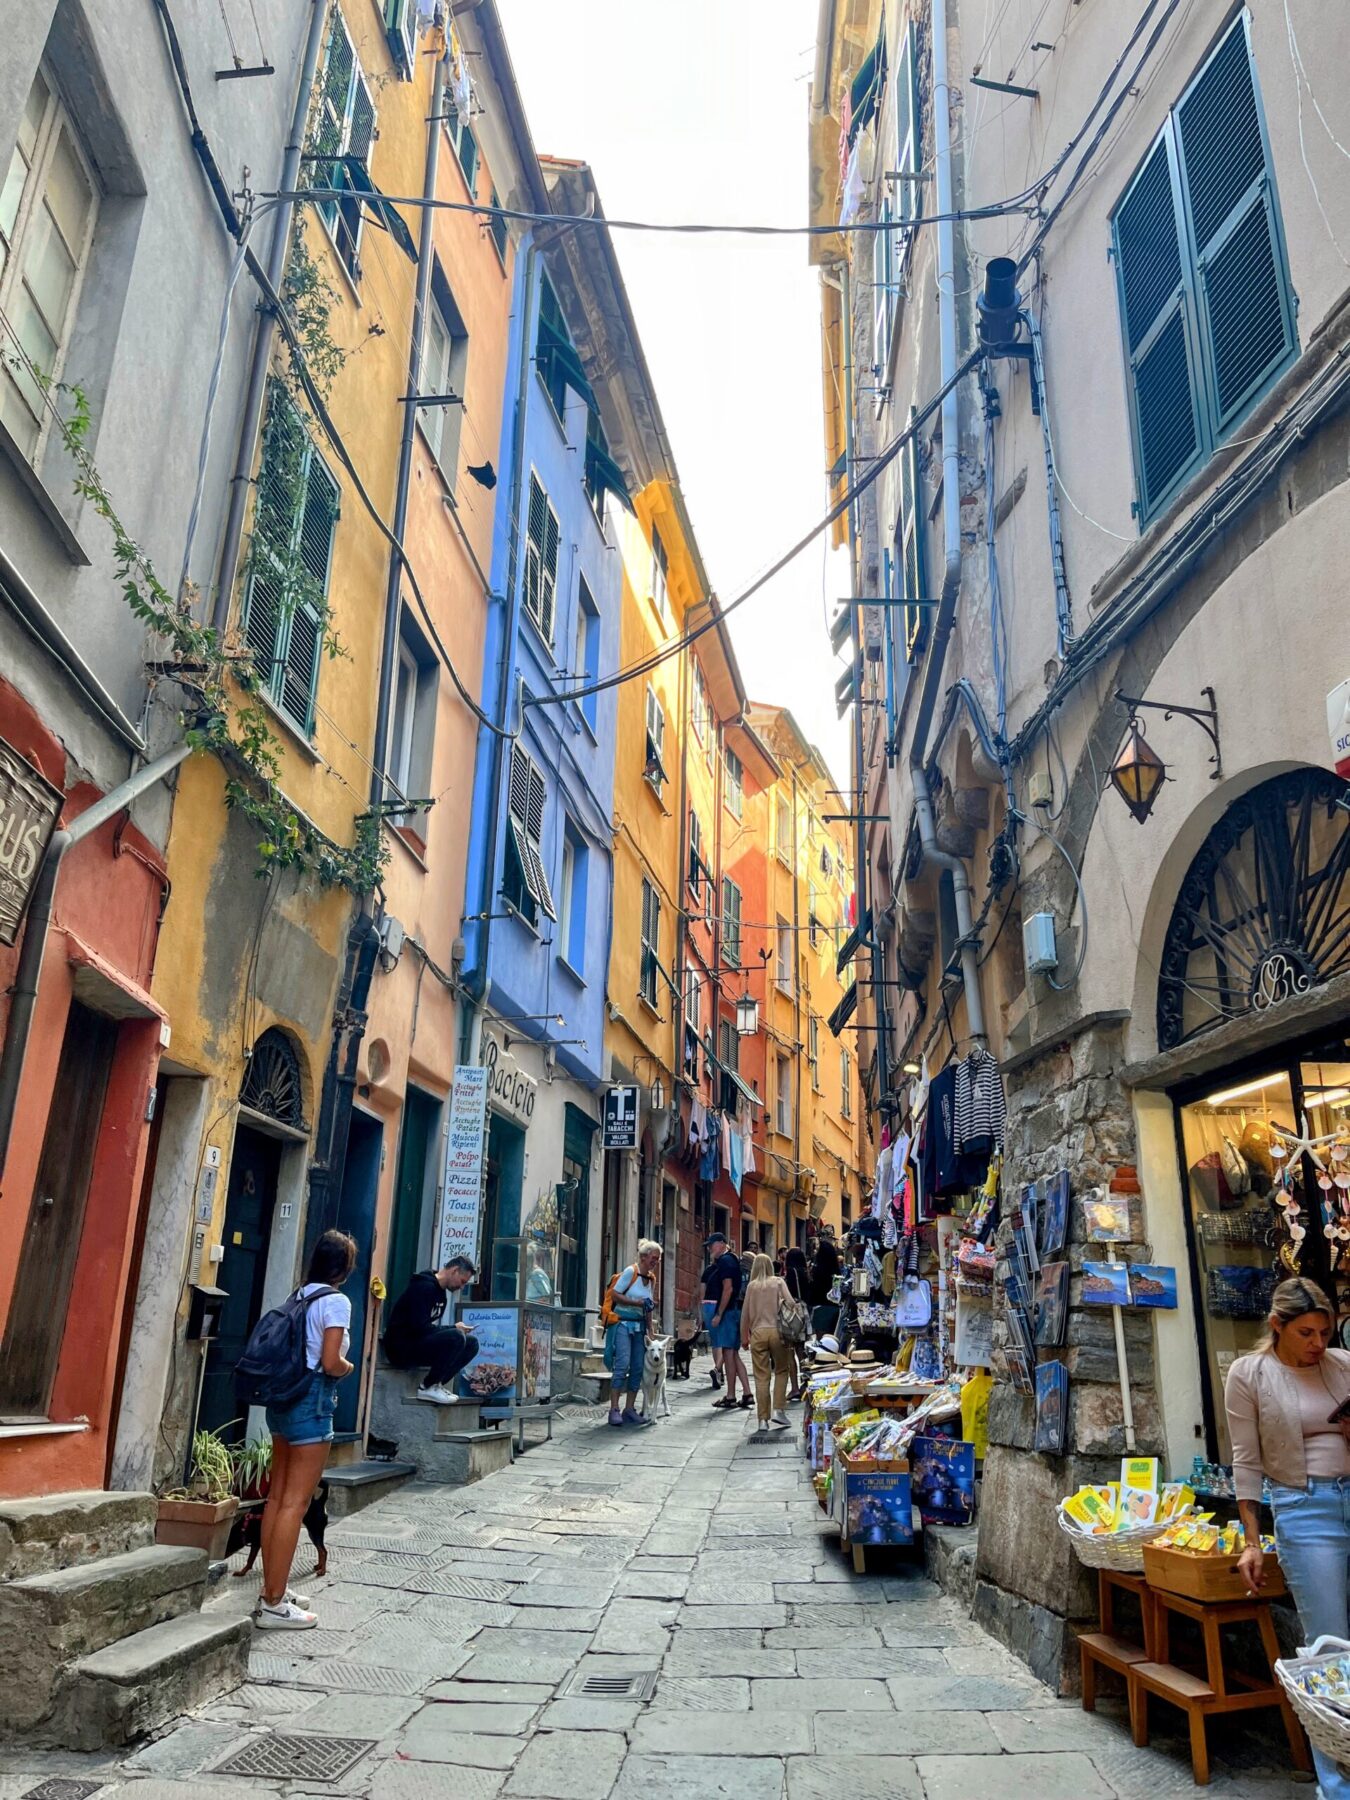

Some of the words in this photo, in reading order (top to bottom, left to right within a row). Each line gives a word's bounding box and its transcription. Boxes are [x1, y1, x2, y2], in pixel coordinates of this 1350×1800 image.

[486, 1041, 536, 1117] Bacicio
[611, 1089, 632, 1120] T
[456, 1124, 480, 1132] Patate
[451, 1134, 480, 1142] Muscoli
[212, 1150, 217, 1162] 9
[456, 1151, 480, 1162] Polpo
[449, 1160, 472, 1168] Patate
[449, 1175, 478, 1185] Pizza
[448, 1187, 477, 1195] Focacce
[448, 1199, 476, 1210] Toast
[282, 1204, 291, 1216] 11
[446, 1214, 475, 1223] Panini
[445, 1227, 473, 1238] Dolci
[444, 1242, 466, 1251] Torte
